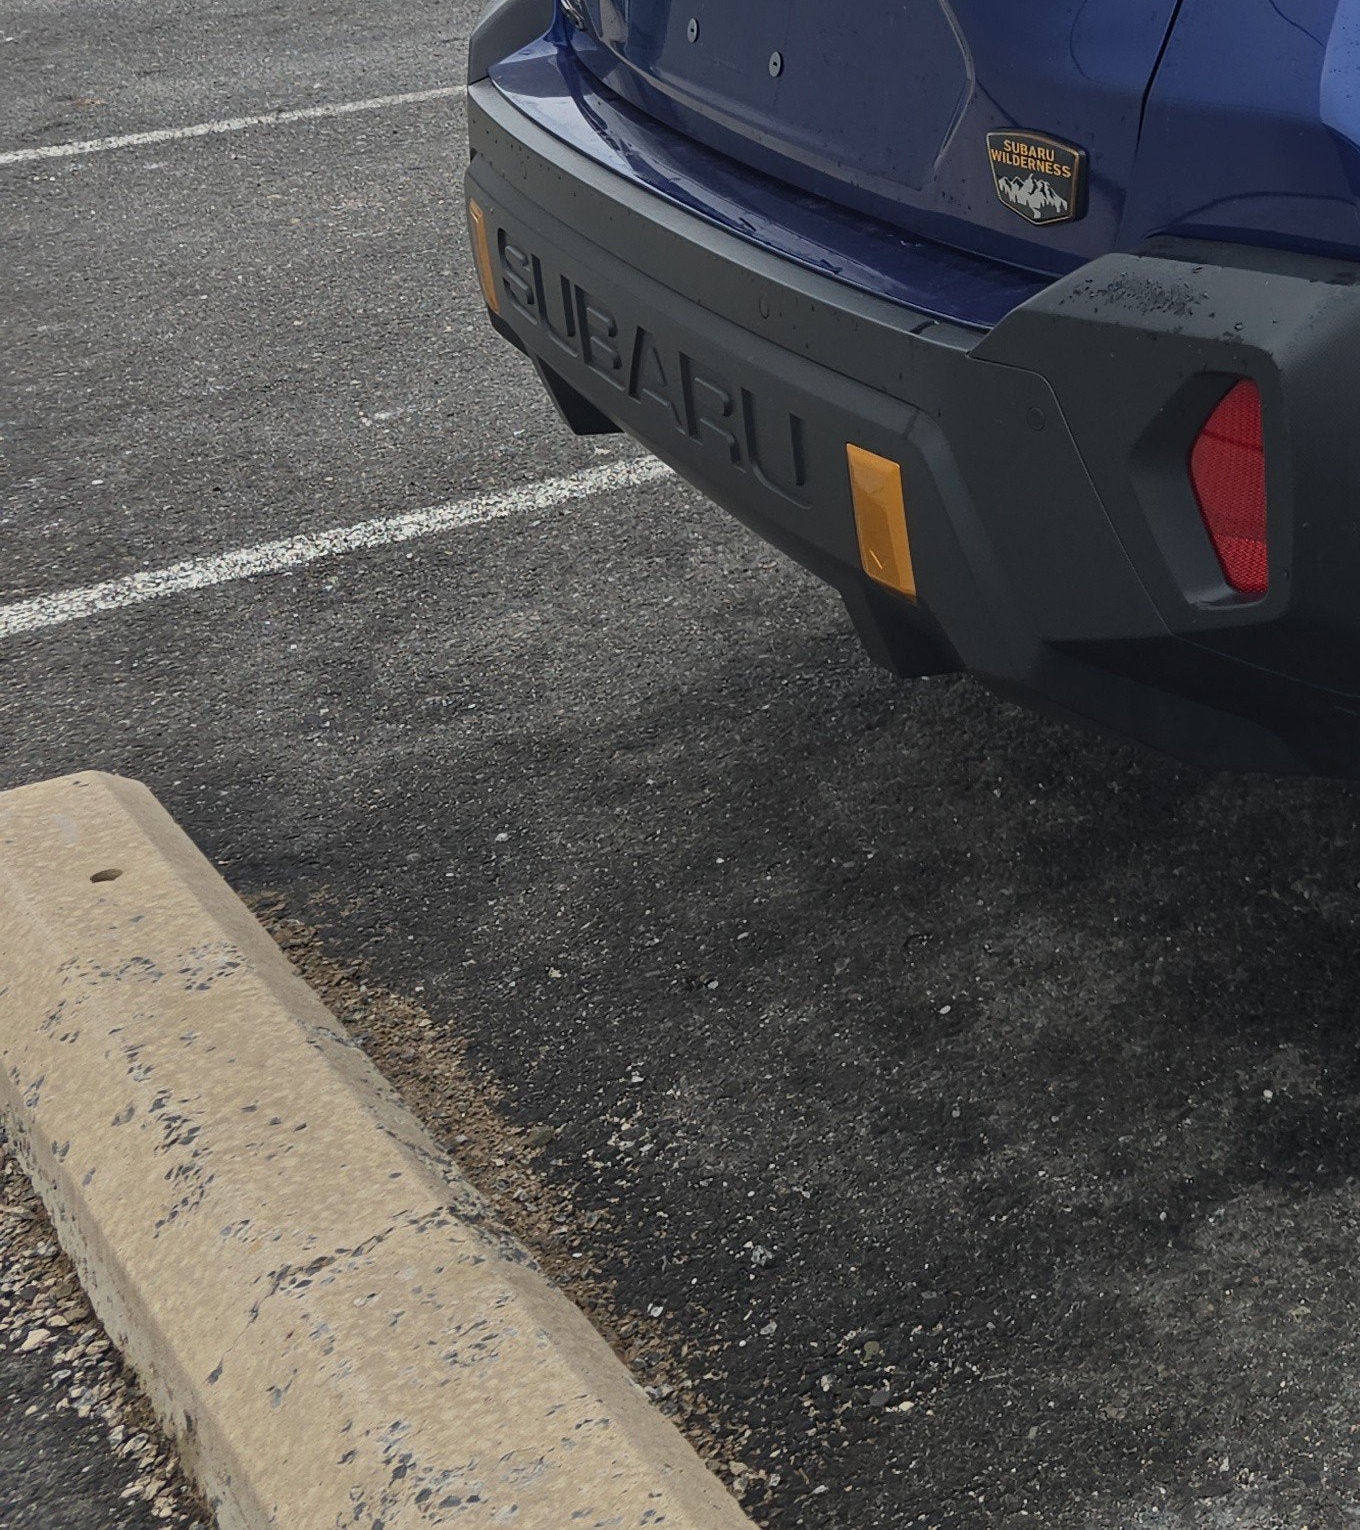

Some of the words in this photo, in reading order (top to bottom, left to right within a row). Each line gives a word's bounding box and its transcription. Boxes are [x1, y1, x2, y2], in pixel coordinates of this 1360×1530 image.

[990, 149, 1072, 178] WILDERNESS
[1003, 139, 1055, 162] SUBARU
[497, 227, 813, 509] SUBARU
